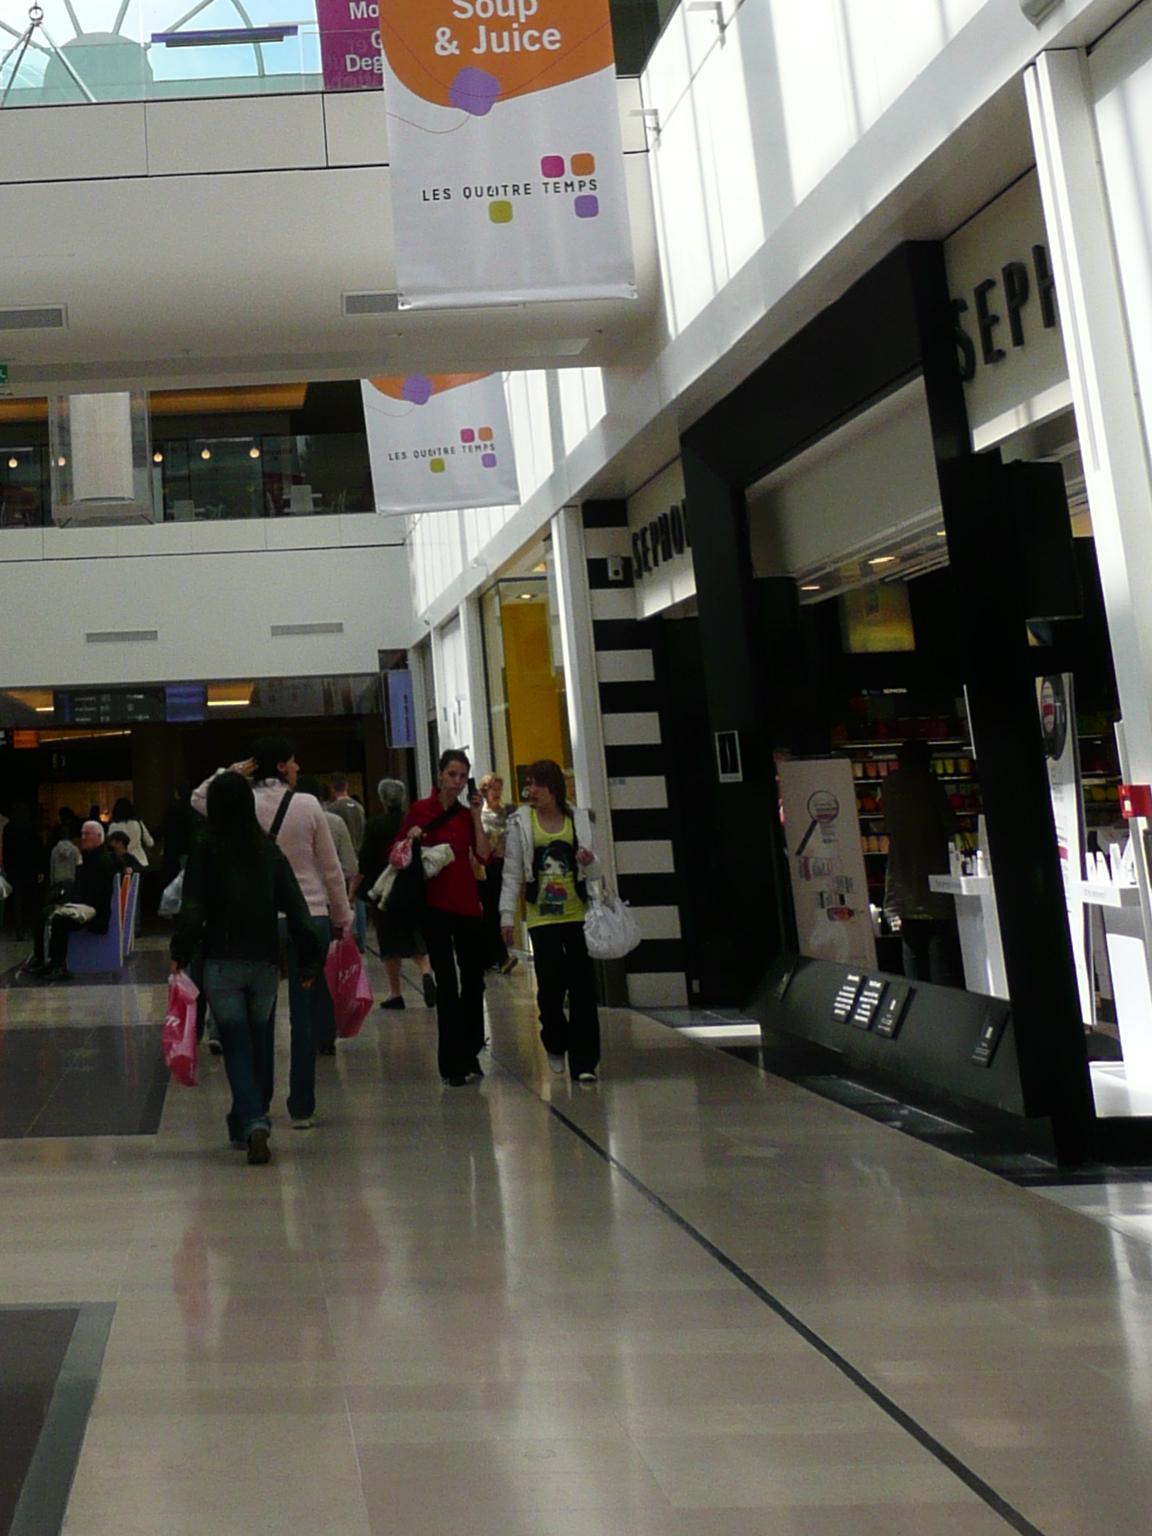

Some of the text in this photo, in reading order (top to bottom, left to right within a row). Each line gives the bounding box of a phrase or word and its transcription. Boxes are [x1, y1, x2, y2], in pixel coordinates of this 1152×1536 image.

[434, 21, 562, 57] & Juice
[421, 186, 452, 201] LES
[542, 179, 599, 195] TEMPS
[388, 451, 407, 461] LES
[461, 443, 496, 454] TEMPS
